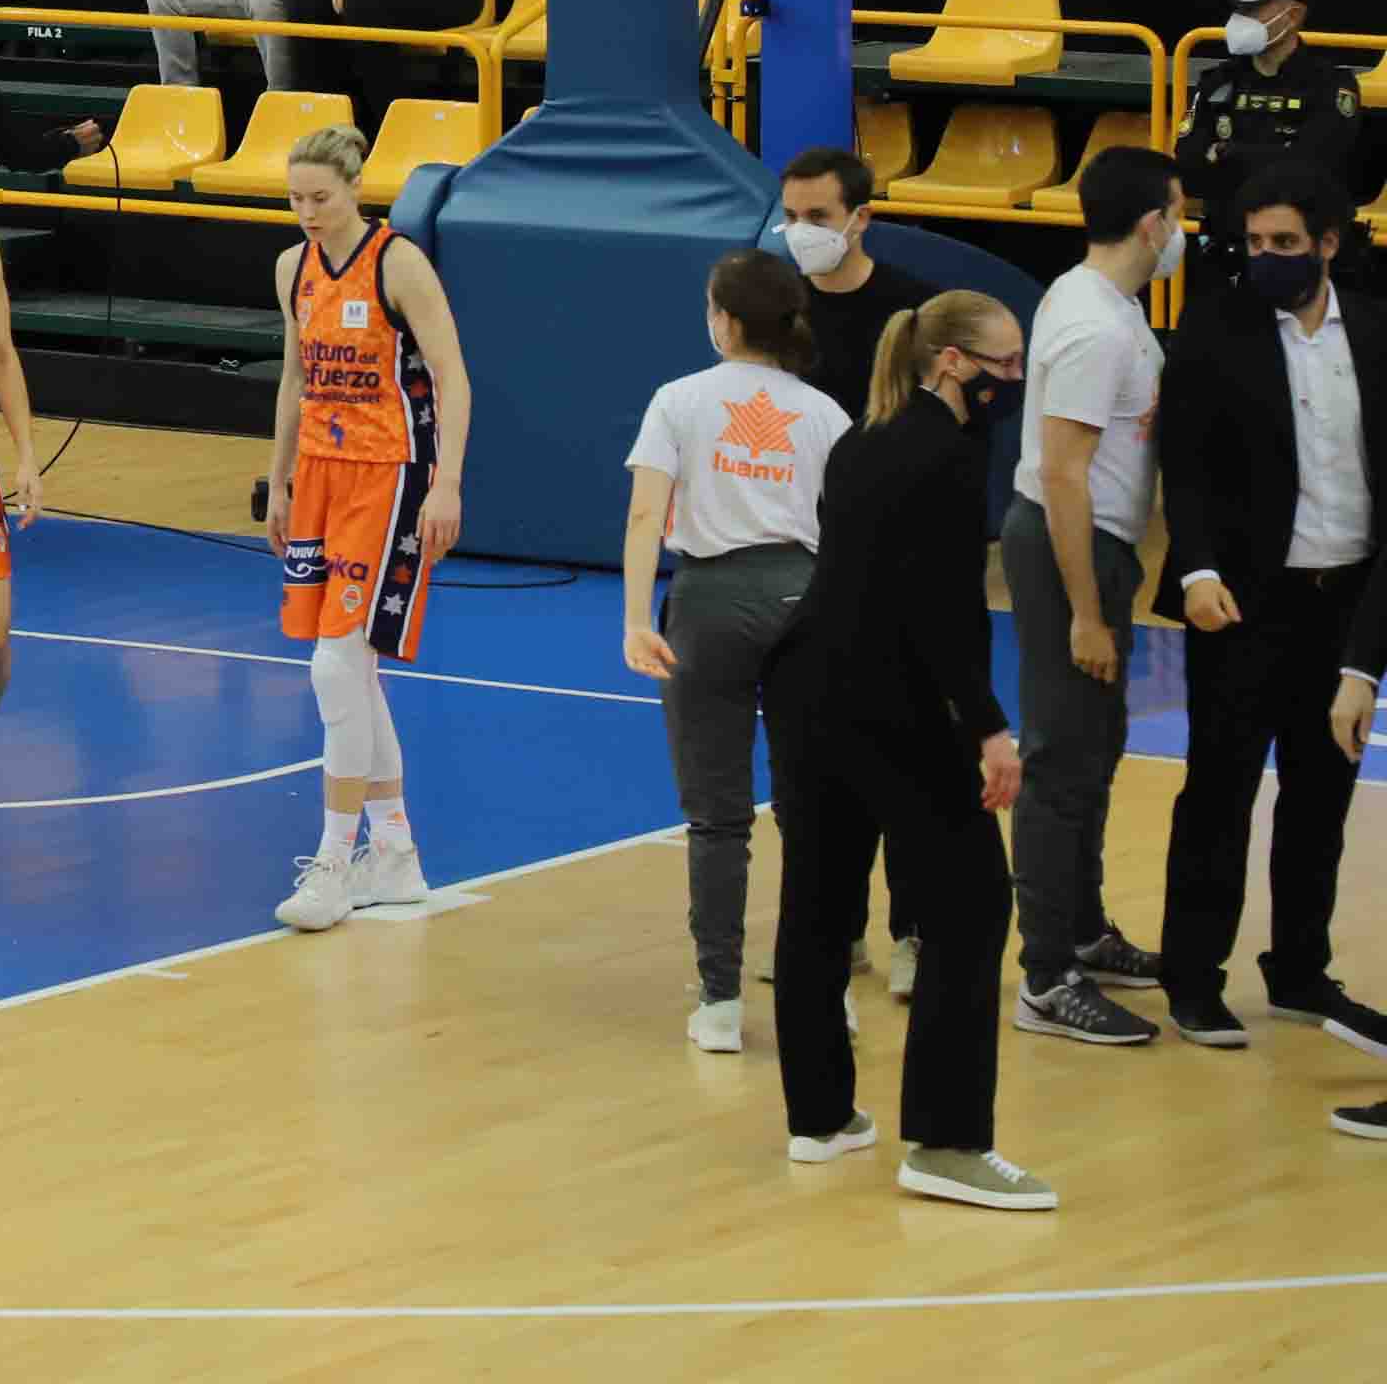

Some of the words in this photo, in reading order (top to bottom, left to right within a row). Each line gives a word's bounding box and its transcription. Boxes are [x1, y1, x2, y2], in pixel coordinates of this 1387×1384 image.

[26, 26, 53, 38] FILA
[54, 27, 63, 38] 2
[713, 449, 796, 485] luanvi
